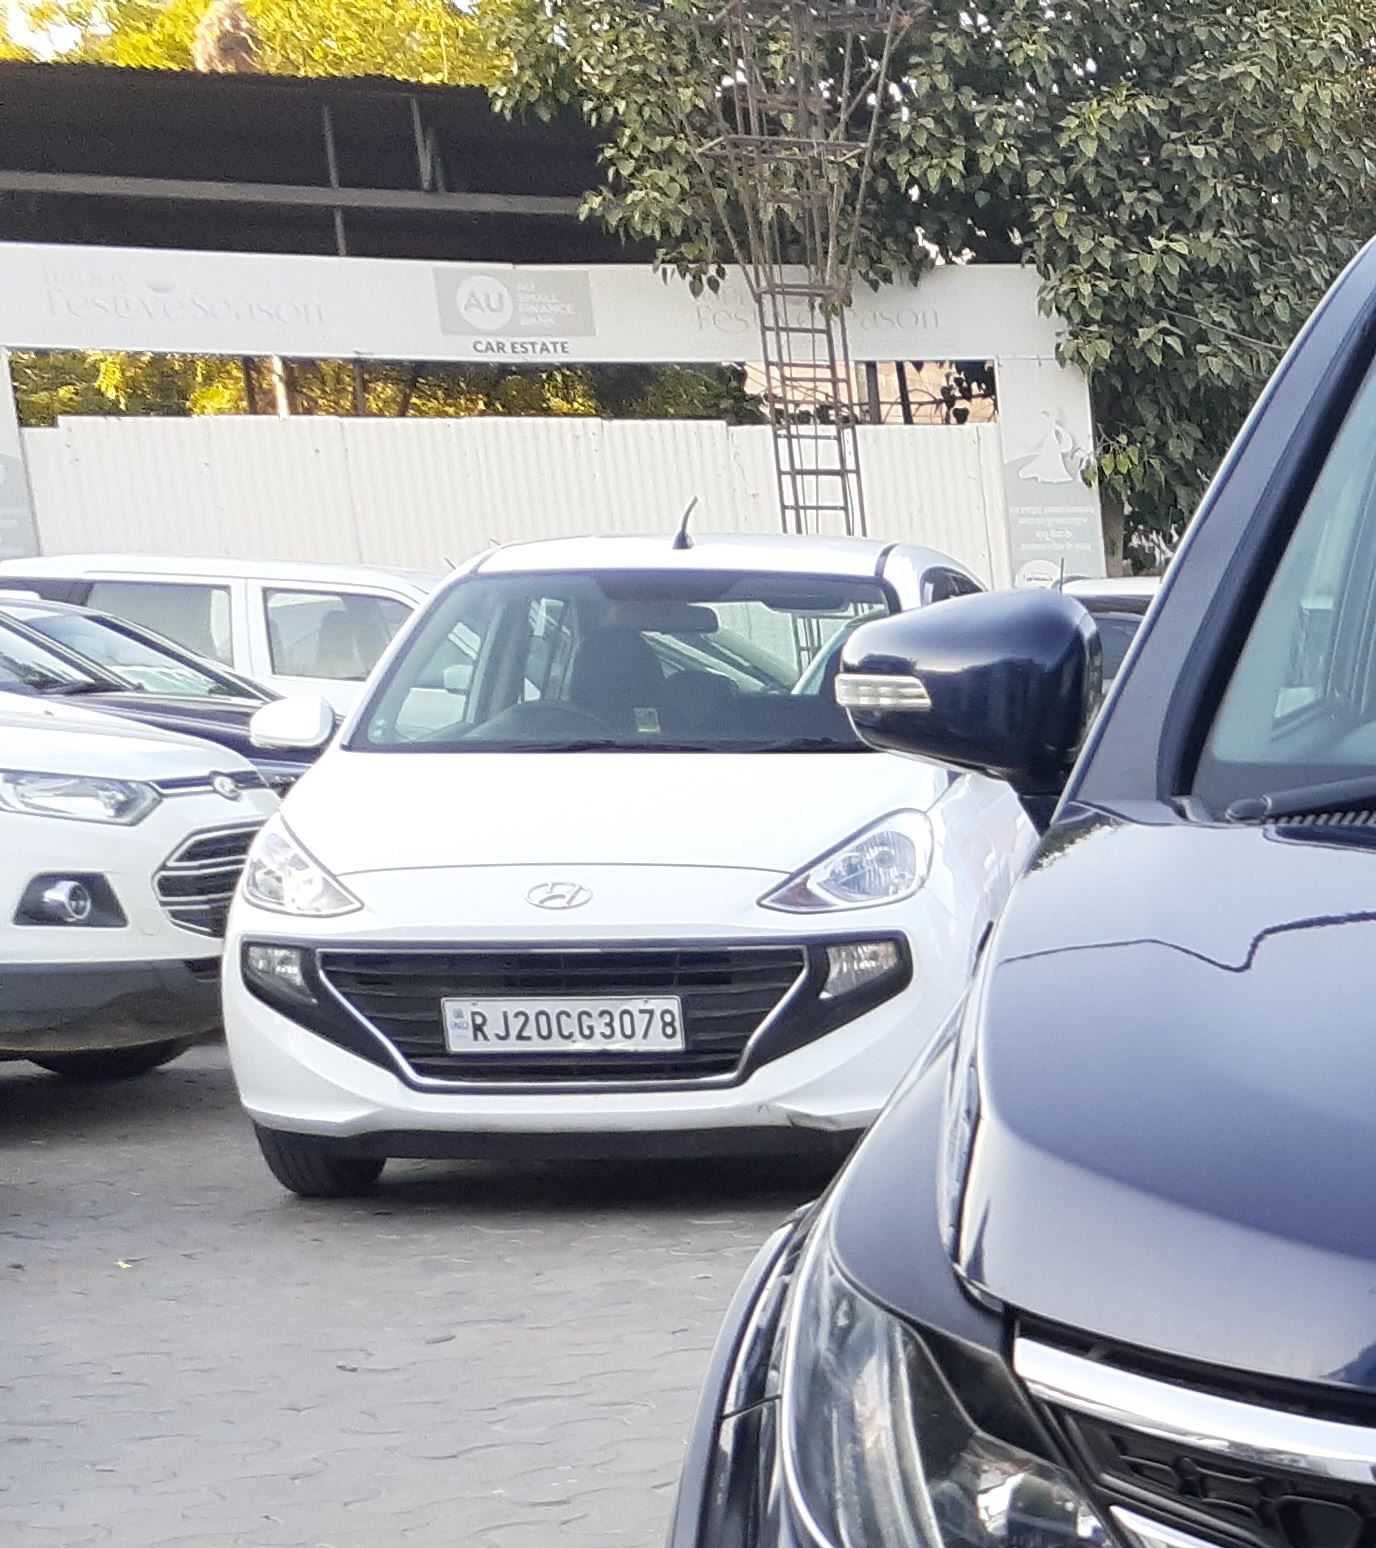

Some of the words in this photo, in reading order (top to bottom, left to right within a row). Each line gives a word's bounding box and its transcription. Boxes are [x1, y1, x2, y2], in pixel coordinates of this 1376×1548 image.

[464, 291, 505, 313] AU
[472, 340, 506, 354] CAR
[511, 341, 570, 354] ESTATE
[470, 1008, 678, 1042] RJ20CG3078
